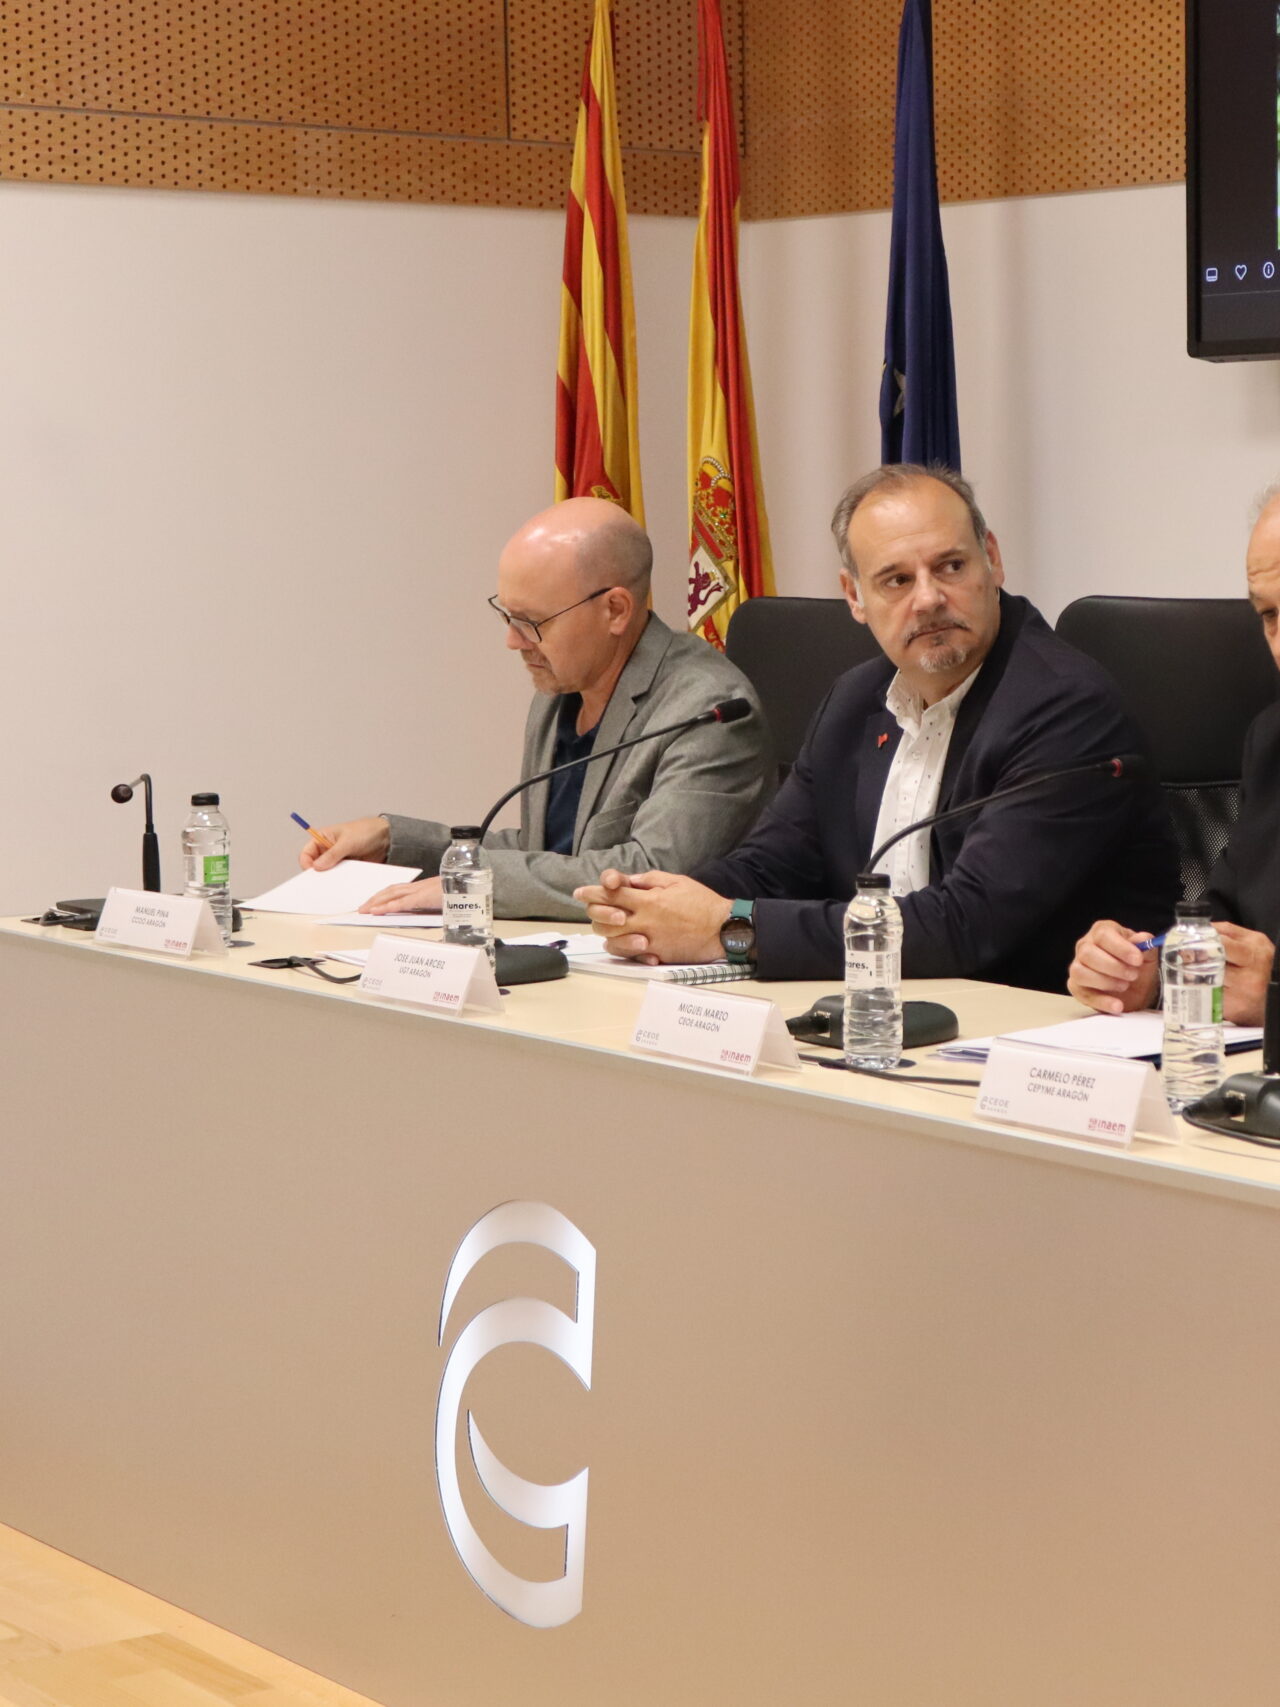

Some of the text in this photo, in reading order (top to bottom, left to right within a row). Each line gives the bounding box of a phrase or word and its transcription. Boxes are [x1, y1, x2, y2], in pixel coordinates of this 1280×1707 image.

[446, 900, 482, 910] lunares.
[678, 1002, 729, 1022] MIGUEL MARZO
[678, 1016, 695, 1028] CEOE
[727, 1050, 752, 1063] inaem
[1030, 1067, 1071, 1085] CARMELO
[1027, 1082, 1056, 1097] CEPYME
[988, 1097, 1010, 1109] CEOE
[1098, 1118, 1127, 1133] inaem
